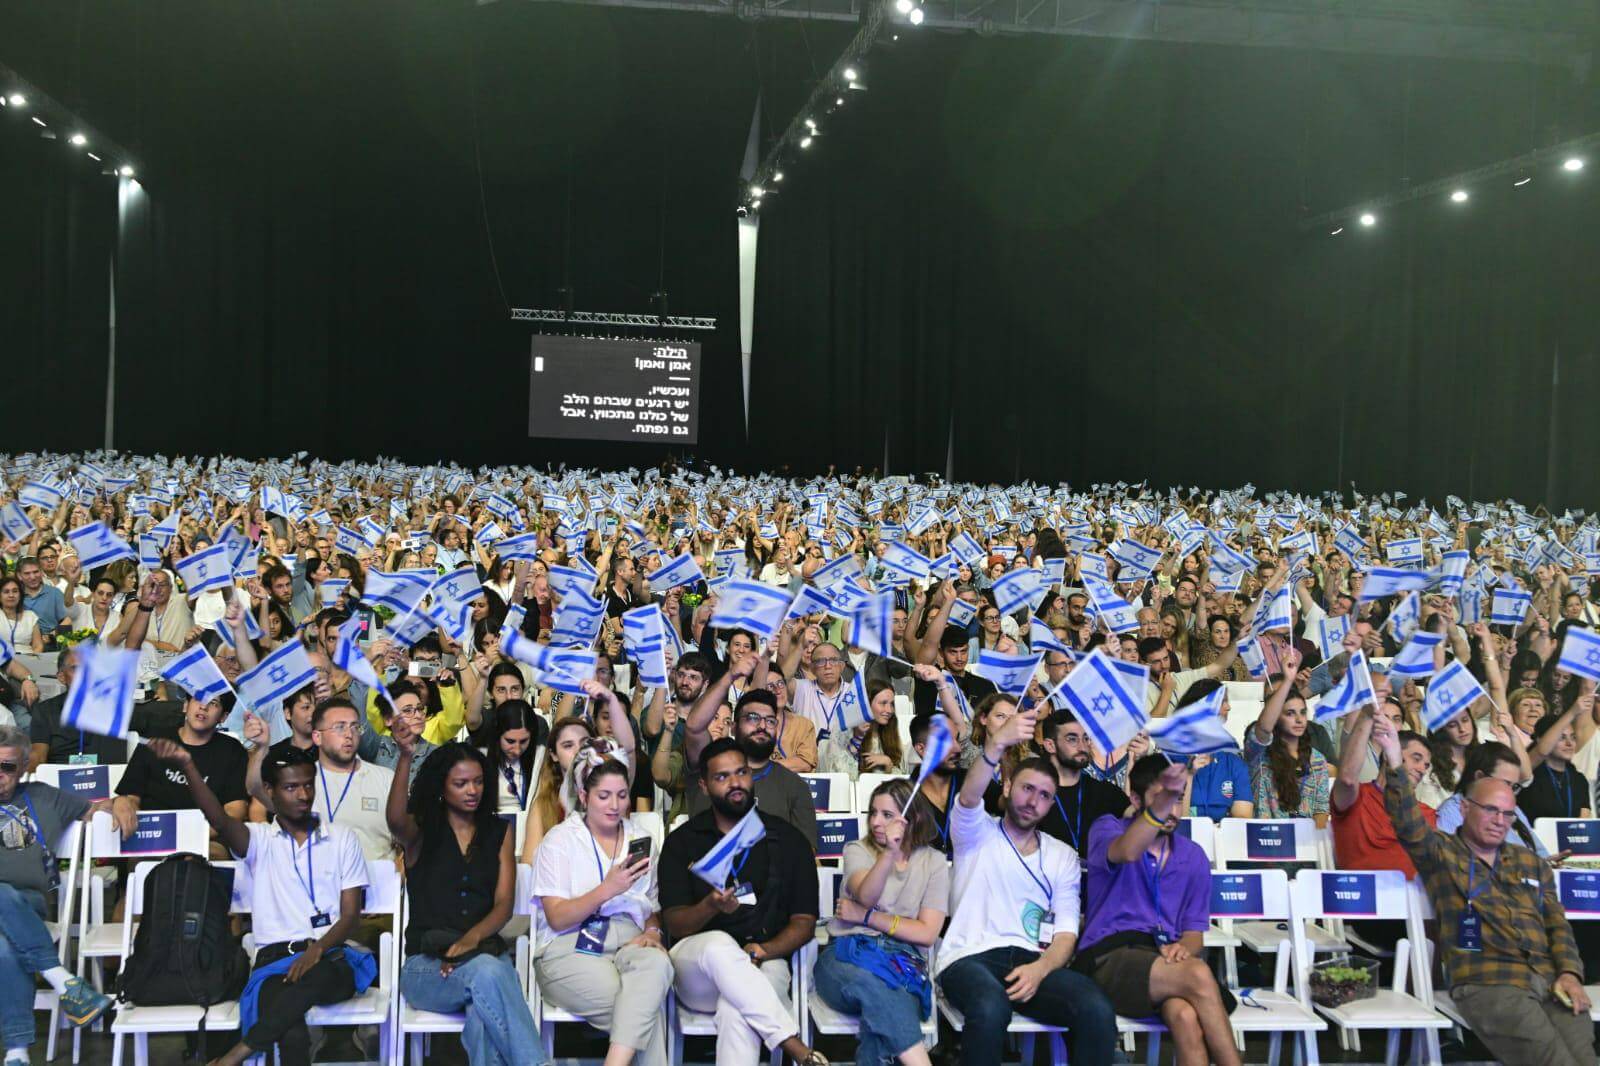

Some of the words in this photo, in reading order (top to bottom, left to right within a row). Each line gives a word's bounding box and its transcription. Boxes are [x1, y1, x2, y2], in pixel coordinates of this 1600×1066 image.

[635, 357, 666, 371] ואמן!
[669, 361, 692, 372] אמן
[563, 393, 590, 405] הלב
[593, 396, 632, 407] שבהם
[635, 398, 671, 409] רגעים
[674, 399, 690, 409] יש
[560, 405, 586, 418] אבל
[671, 410, 690, 422] של
[632, 423, 669, 435] נפתח.
[673, 425, 689, 435] גם
[72, 781, 97, 791] שמור
[821, 834, 846, 843] שמור
[1258, 838, 1282, 846] שמור
[1566, 835, 1590, 843] שמור
[1220, 891, 1248, 901] שמור
[1334, 890, 1361, 900] שמור
[1572, 889, 1599, 898] שמור
